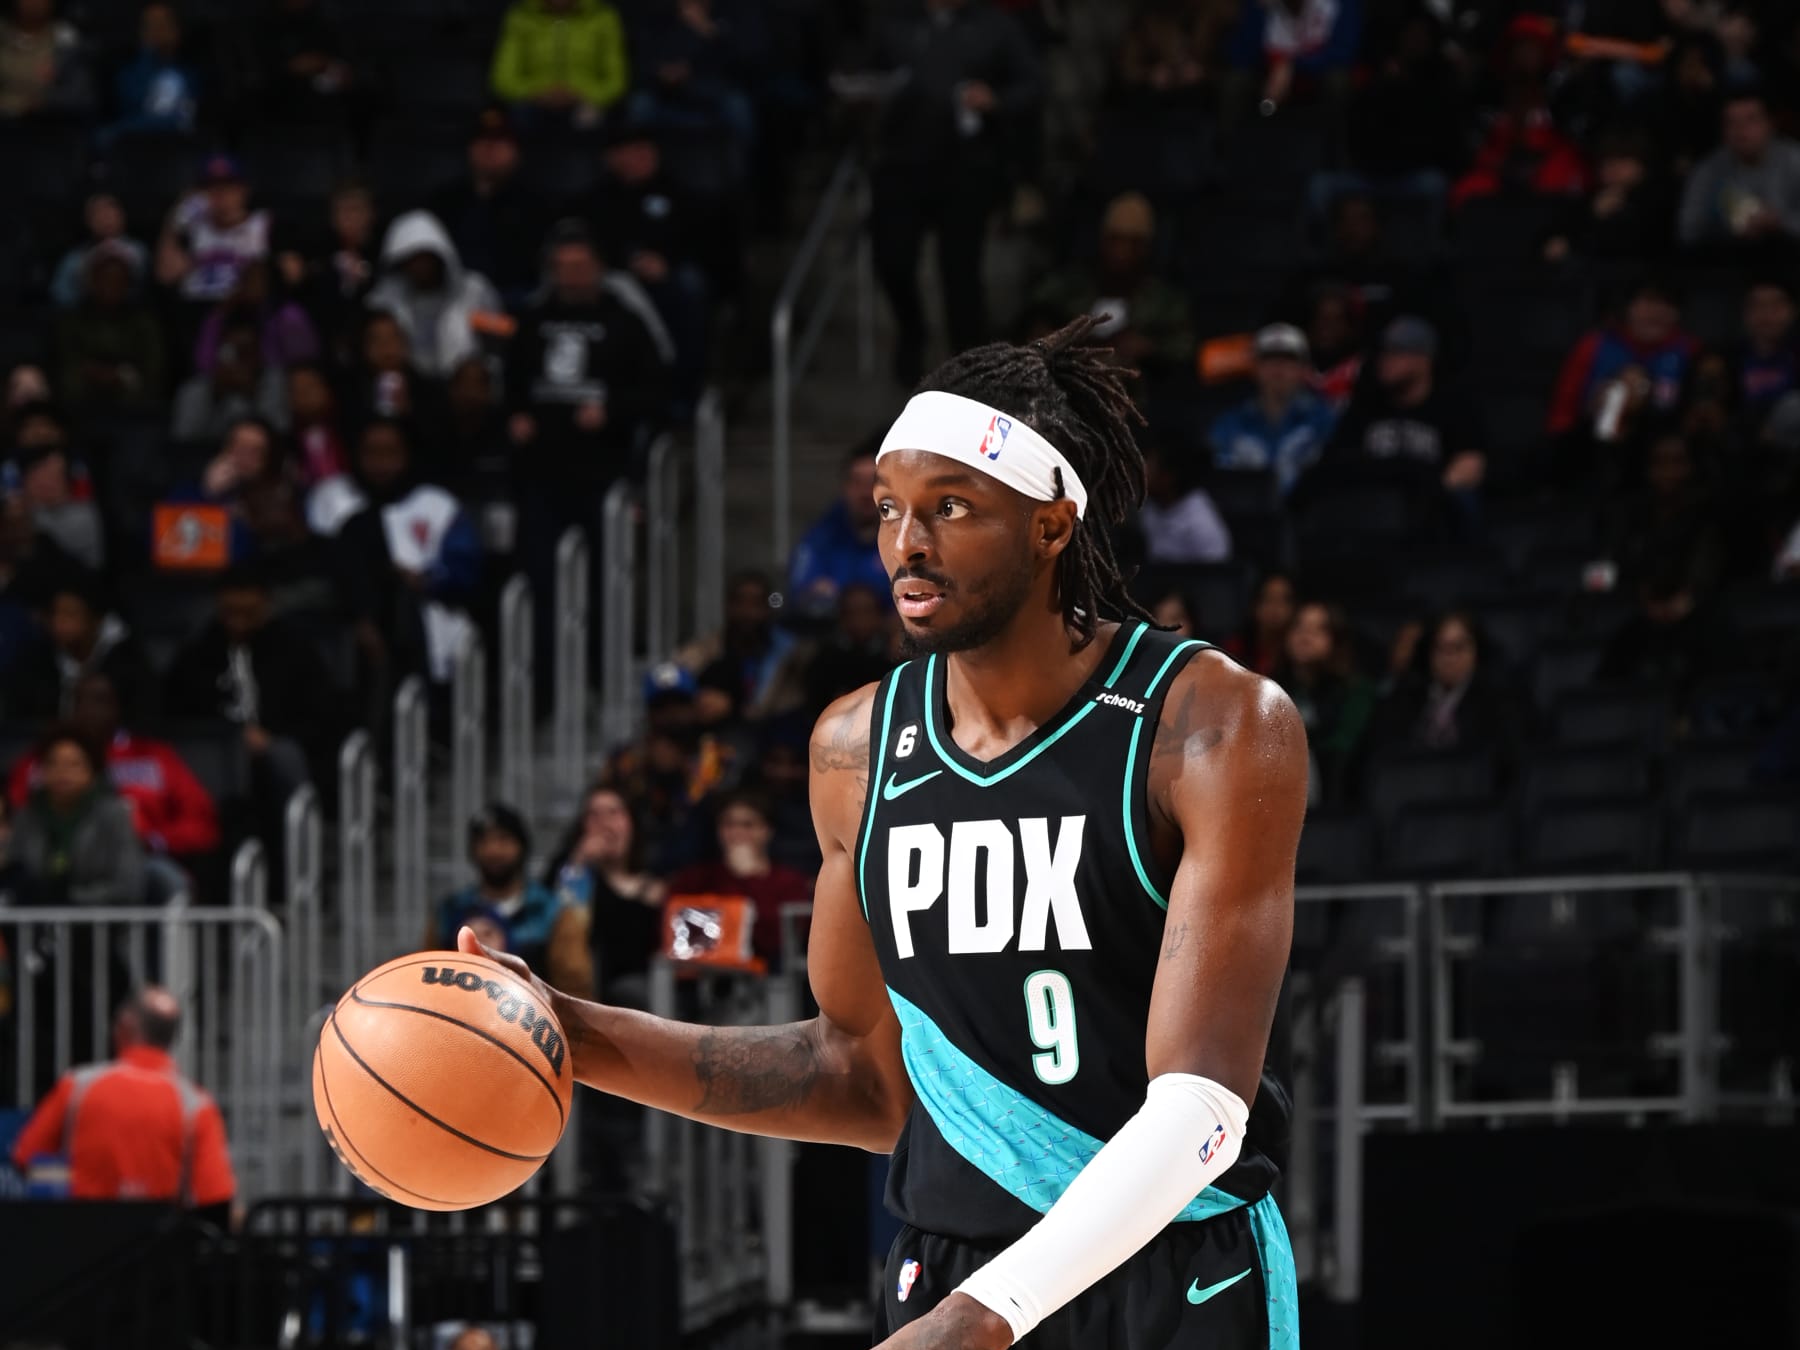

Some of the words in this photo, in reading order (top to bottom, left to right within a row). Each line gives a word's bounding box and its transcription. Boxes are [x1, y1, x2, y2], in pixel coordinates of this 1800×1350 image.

[895, 725, 918, 758] 6
[887, 814, 1093, 960] PDX
[1023, 969, 1080, 1085] 9
